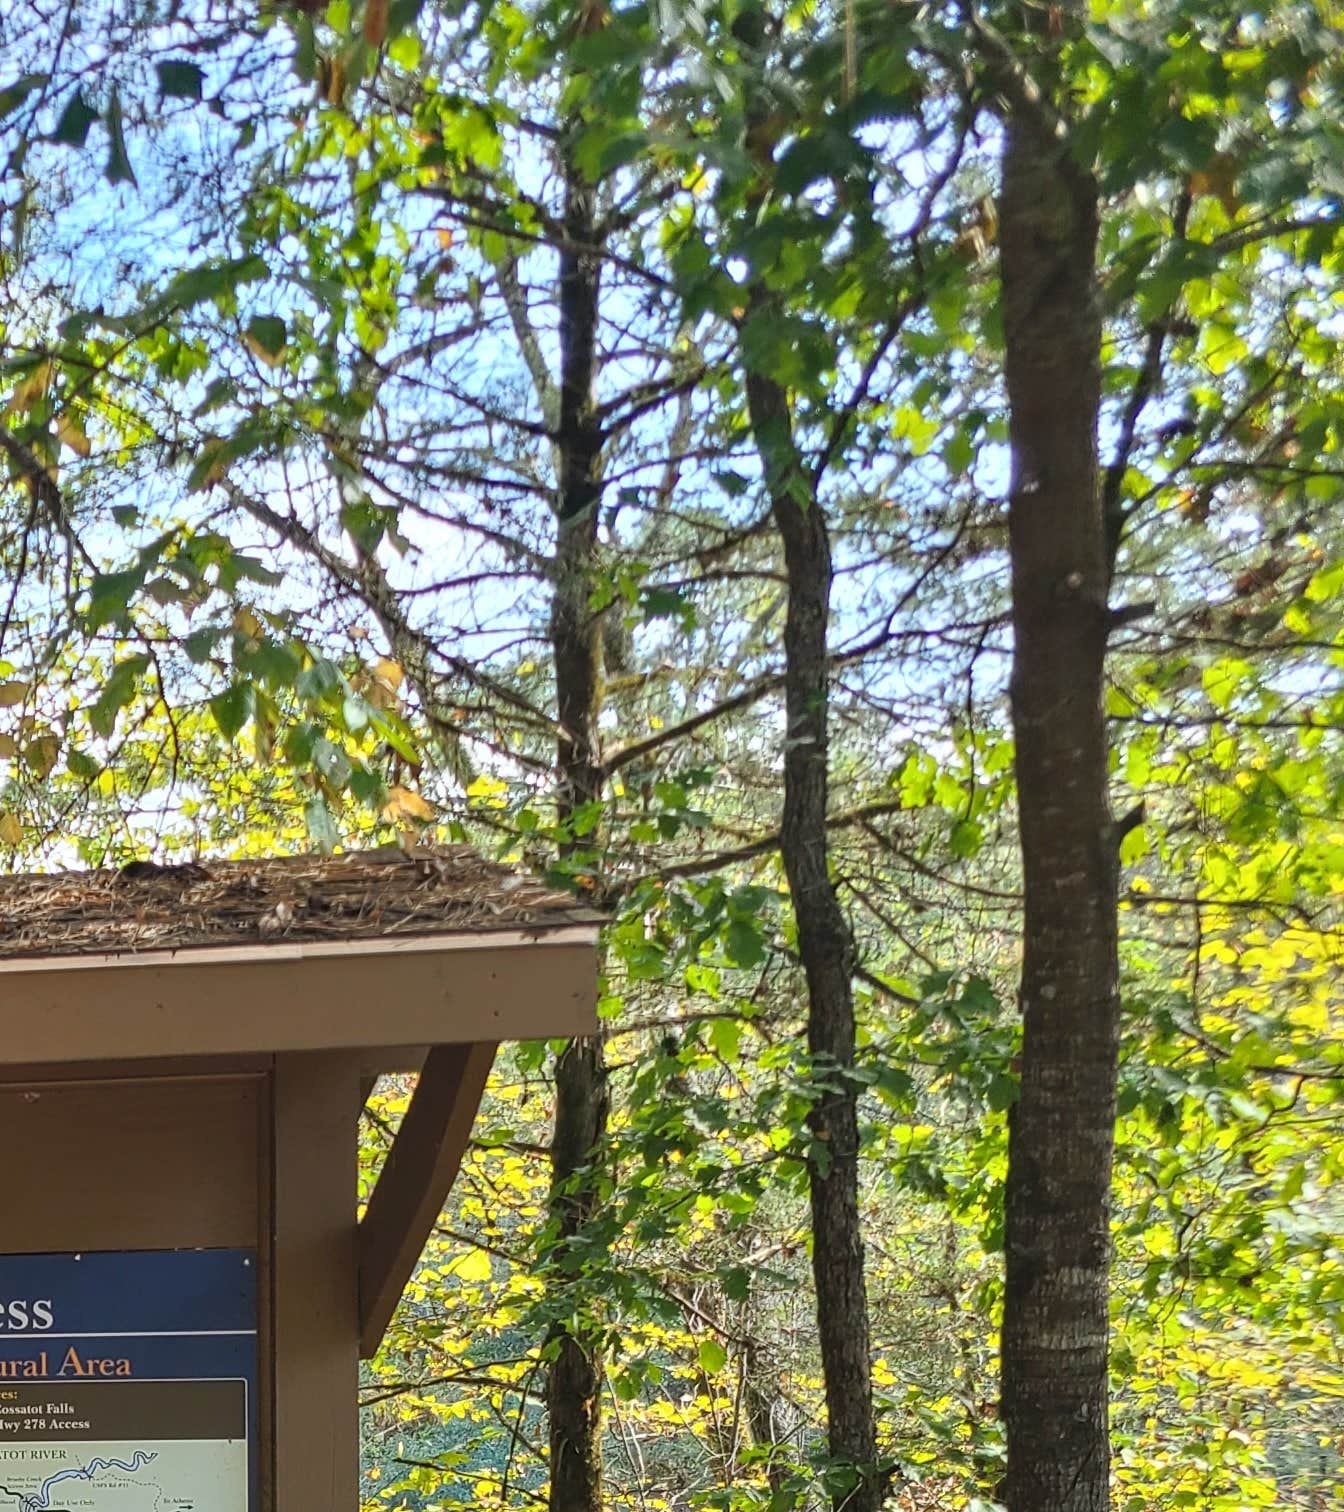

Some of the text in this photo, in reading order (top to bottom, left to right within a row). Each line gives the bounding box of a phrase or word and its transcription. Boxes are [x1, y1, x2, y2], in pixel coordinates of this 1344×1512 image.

[57, 1346, 131, 1376] Area
[46, 1403, 75, 1414] Falls
[23, 1418, 46, 1429] 278
[49, 1418, 90, 1429] Access
[30, 1450, 67, 1460] RIVER
